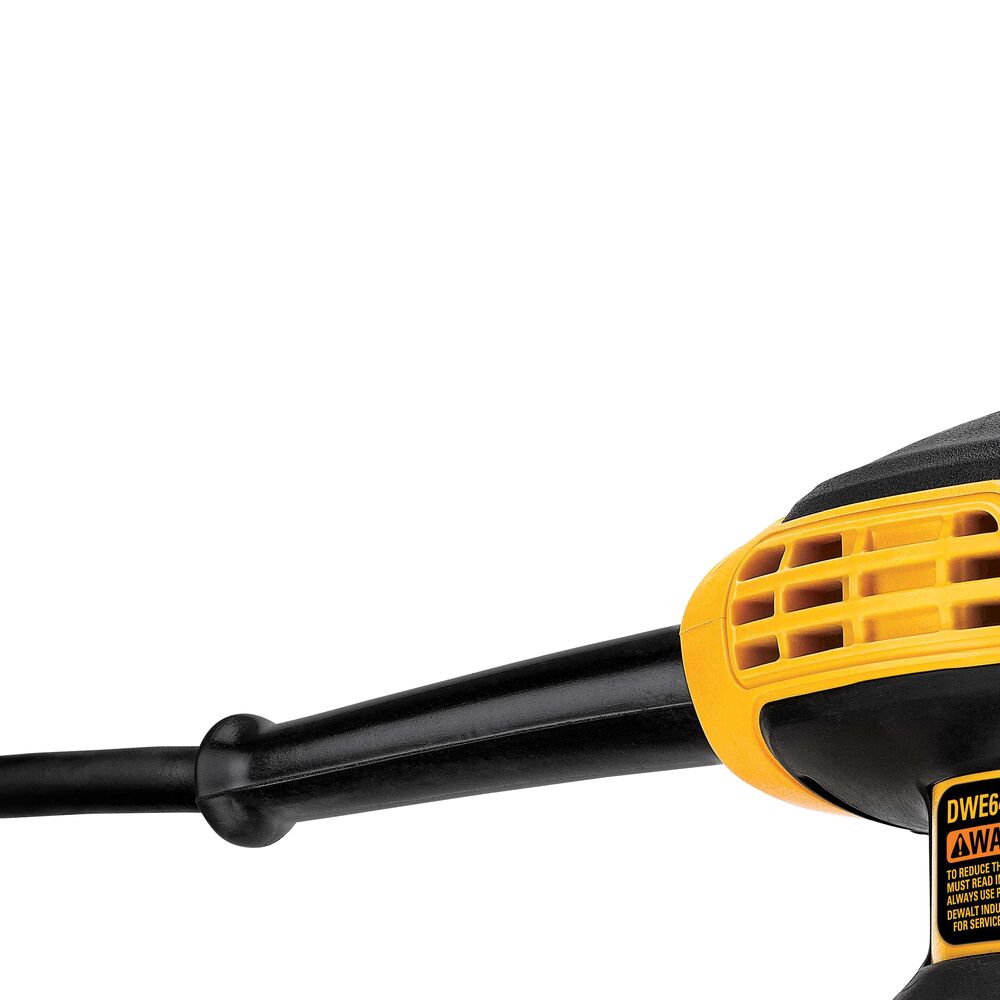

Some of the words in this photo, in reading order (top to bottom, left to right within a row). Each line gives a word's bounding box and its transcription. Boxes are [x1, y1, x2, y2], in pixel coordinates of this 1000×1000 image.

[946, 869, 957, 880] TO
[959, 863, 990, 878] REDUCE
[946, 879, 970, 893] MUST
[972, 875, 993, 888] READ
[946, 890, 979, 906] ALWAYS
[980, 888, 995, 900] USE
[947, 905, 979, 920] DEWALT
[953, 921, 968, 932] FOR
